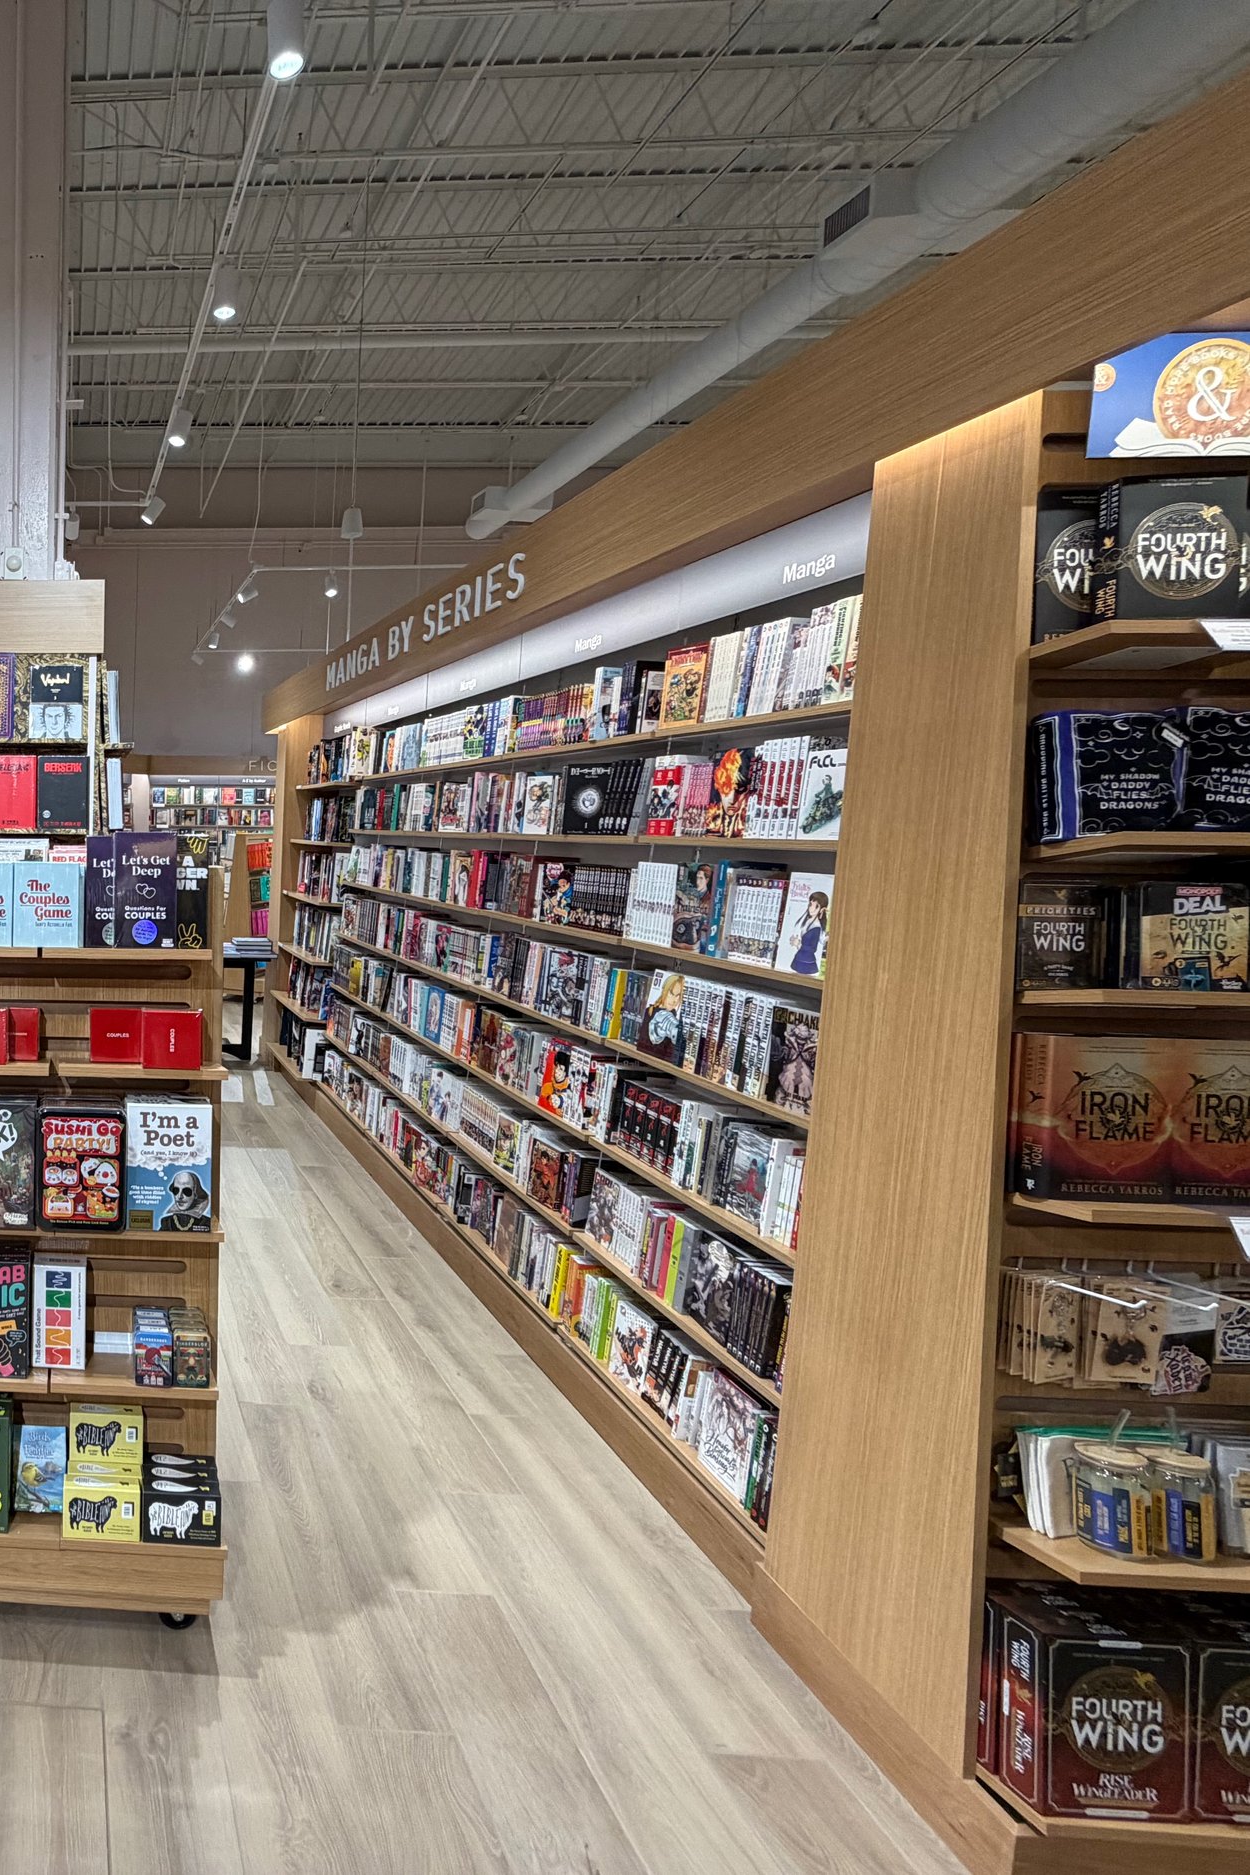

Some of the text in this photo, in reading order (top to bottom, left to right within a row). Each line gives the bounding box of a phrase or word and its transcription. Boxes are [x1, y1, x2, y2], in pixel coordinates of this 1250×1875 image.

[1190, 348, 1236, 363] BOOKS
[1187, 366, 1238, 421] &
[1110, 484, 1120, 528] REBECCA
[1136, 531, 1227, 553] FOURTH
[782, 553, 836, 584] Manga
[1136, 552, 1228, 581] WING
[1095, 588, 1105, 615] WING
[1106, 579, 1117, 618] FOURTH
[325, 552, 526, 692] MANGA BY SERIES
[575, 633, 602, 653] Manga
[43, 761, 84, 774] BERSERK
[809, 753, 837, 769] FLCL
[1111, 781, 1151, 789] DADDY
[1113, 791, 1147, 799] FLIES
[1100, 801, 1160, 809] DRAGONS
[121, 854, 171, 866] Let's Get
[132, 865, 162, 879] Deep
[28, 879, 50, 892] The
[20, 892, 70, 907] Couples
[1173, 896, 1227, 915] DEAL
[34, 906, 72, 921] Game
[124, 911, 167, 920] COUPLES
[1026, 906, 1097, 916] PRIORITIES
[1033, 922, 1085, 934] FOURTH
[1170, 918, 1227, 932] FOURTH
[1033, 934, 1085, 951] WING
[1169, 933, 1228, 950] WING
[653, 977, 661, 988] 01
[762, 1006, 773, 1043] FULLMETAL
[1080, 1091, 1150, 1116] IRON
[140, 1111, 199, 1129] I'm a
[97, 1121, 123, 1138] GO
[1075, 1123, 1155, 1142] FLAME
[52, 1136, 113, 1151] PARTY!
[143, 1130, 195, 1148] Poet
[1031, 1144, 1043, 1167] IRON
[1061, 1184, 1164, 1196] REBECCA YARROS
[1175, 1186, 1228, 1197] REBECCA
[1011, 1640, 1021, 1668] WING
[1020, 1639, 1030, 1682] FOURTH
[1071, 1697, 1163, 1723] FOURTH
[1070, 1719, 1165, 1754] WING
[1099, 1772, 1135, 1787] RISE
[1072, 1782, 1160, 1802] WINGLEADER
